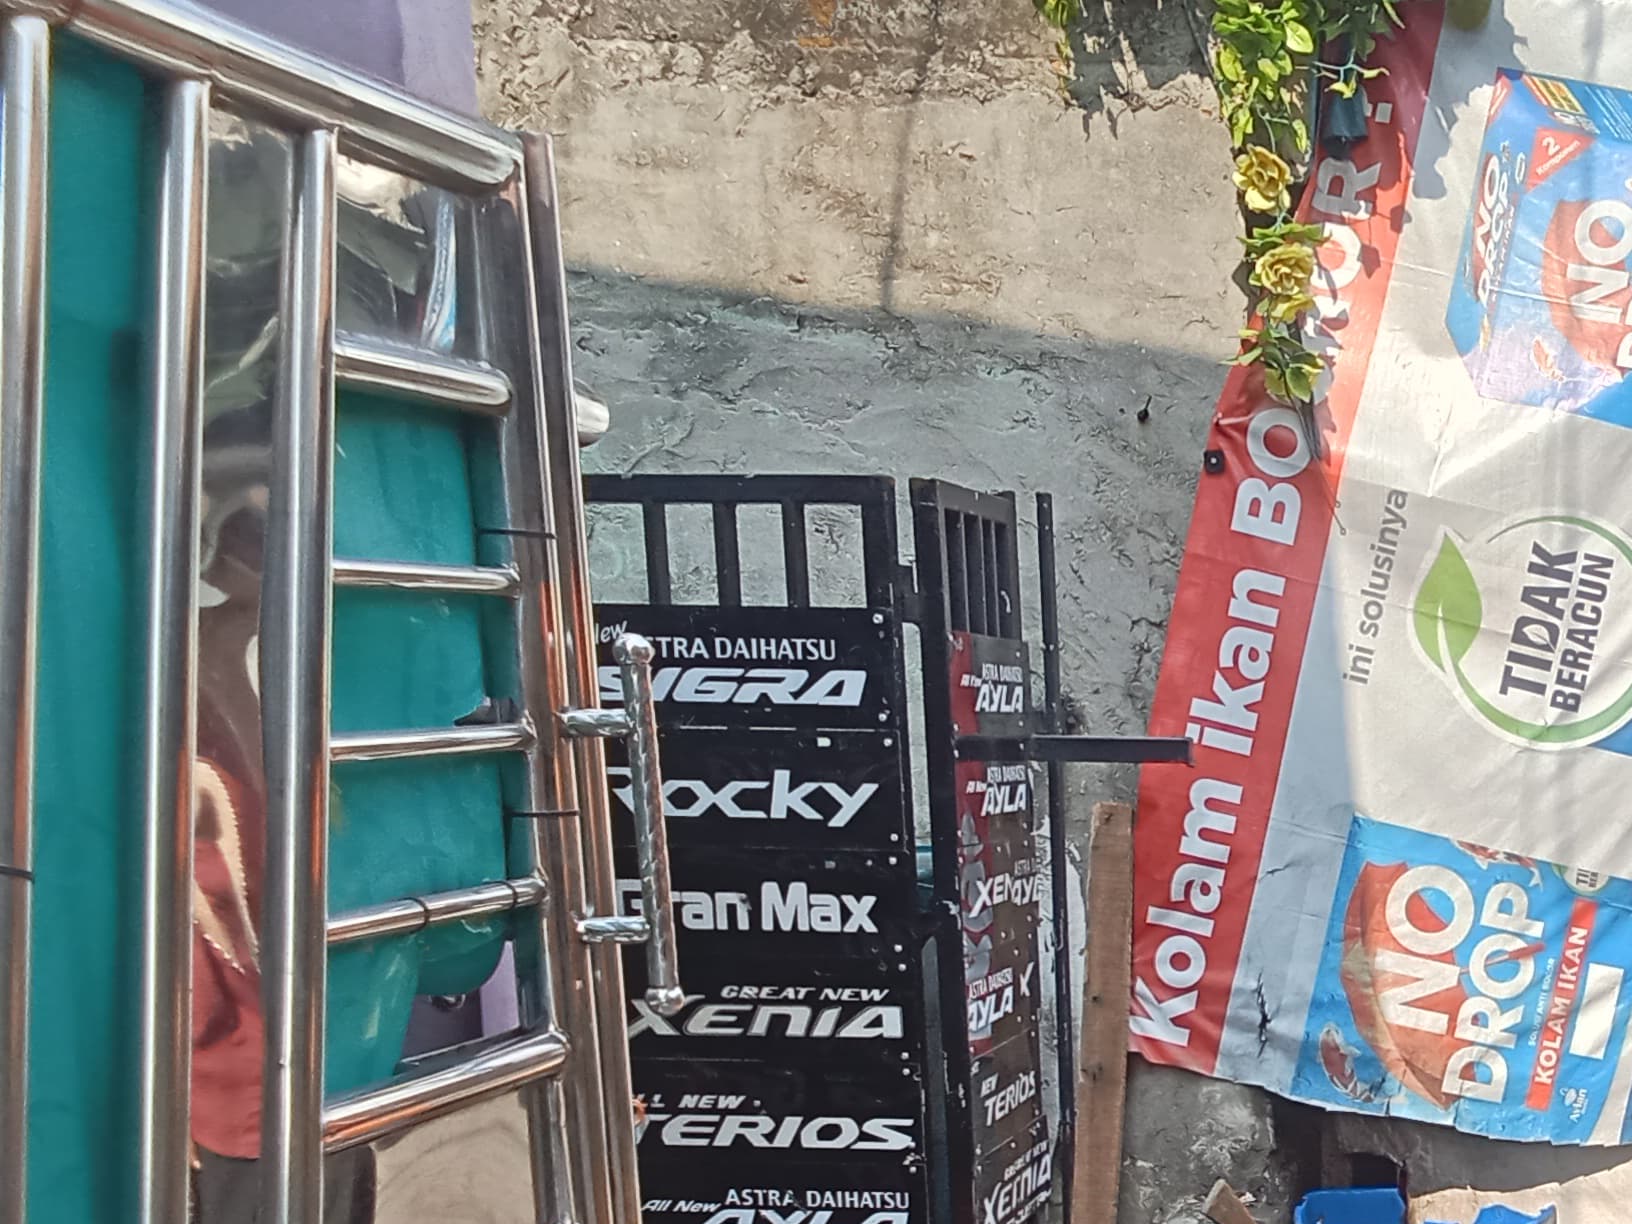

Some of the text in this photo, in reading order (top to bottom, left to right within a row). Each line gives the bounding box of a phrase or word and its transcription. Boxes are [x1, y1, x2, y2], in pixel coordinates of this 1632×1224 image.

[1342, 488, 1409, 685] ini solusinya
[1498, 540, 1579, 697] TIDAK
[1549, 552, 1615, 713] BERACUN
[714, 637, 837, 662] DAIHATSU
[974, 683, 1024, 713] AYLA
[1184, 566, 1287, 758] ikan
[981, 783, 1027, 817] AYLA
[761, 881, 879, 934] Max
[1129, 779, 1244, 1048] Kolam
[1373, 865, 1475, 1036] NO
[720, 984, 890, 1002] GREAT NEW
[1440, 881, 1546, 1104] DROP
[1533, 926, 1589, 1085] KOLAM IKAN
[678, 1094, 747, 1110] NEW
[673, 1199, 722, 1213] New
[725, 1188, 911, 1210] ASTRA DAIHATSU
